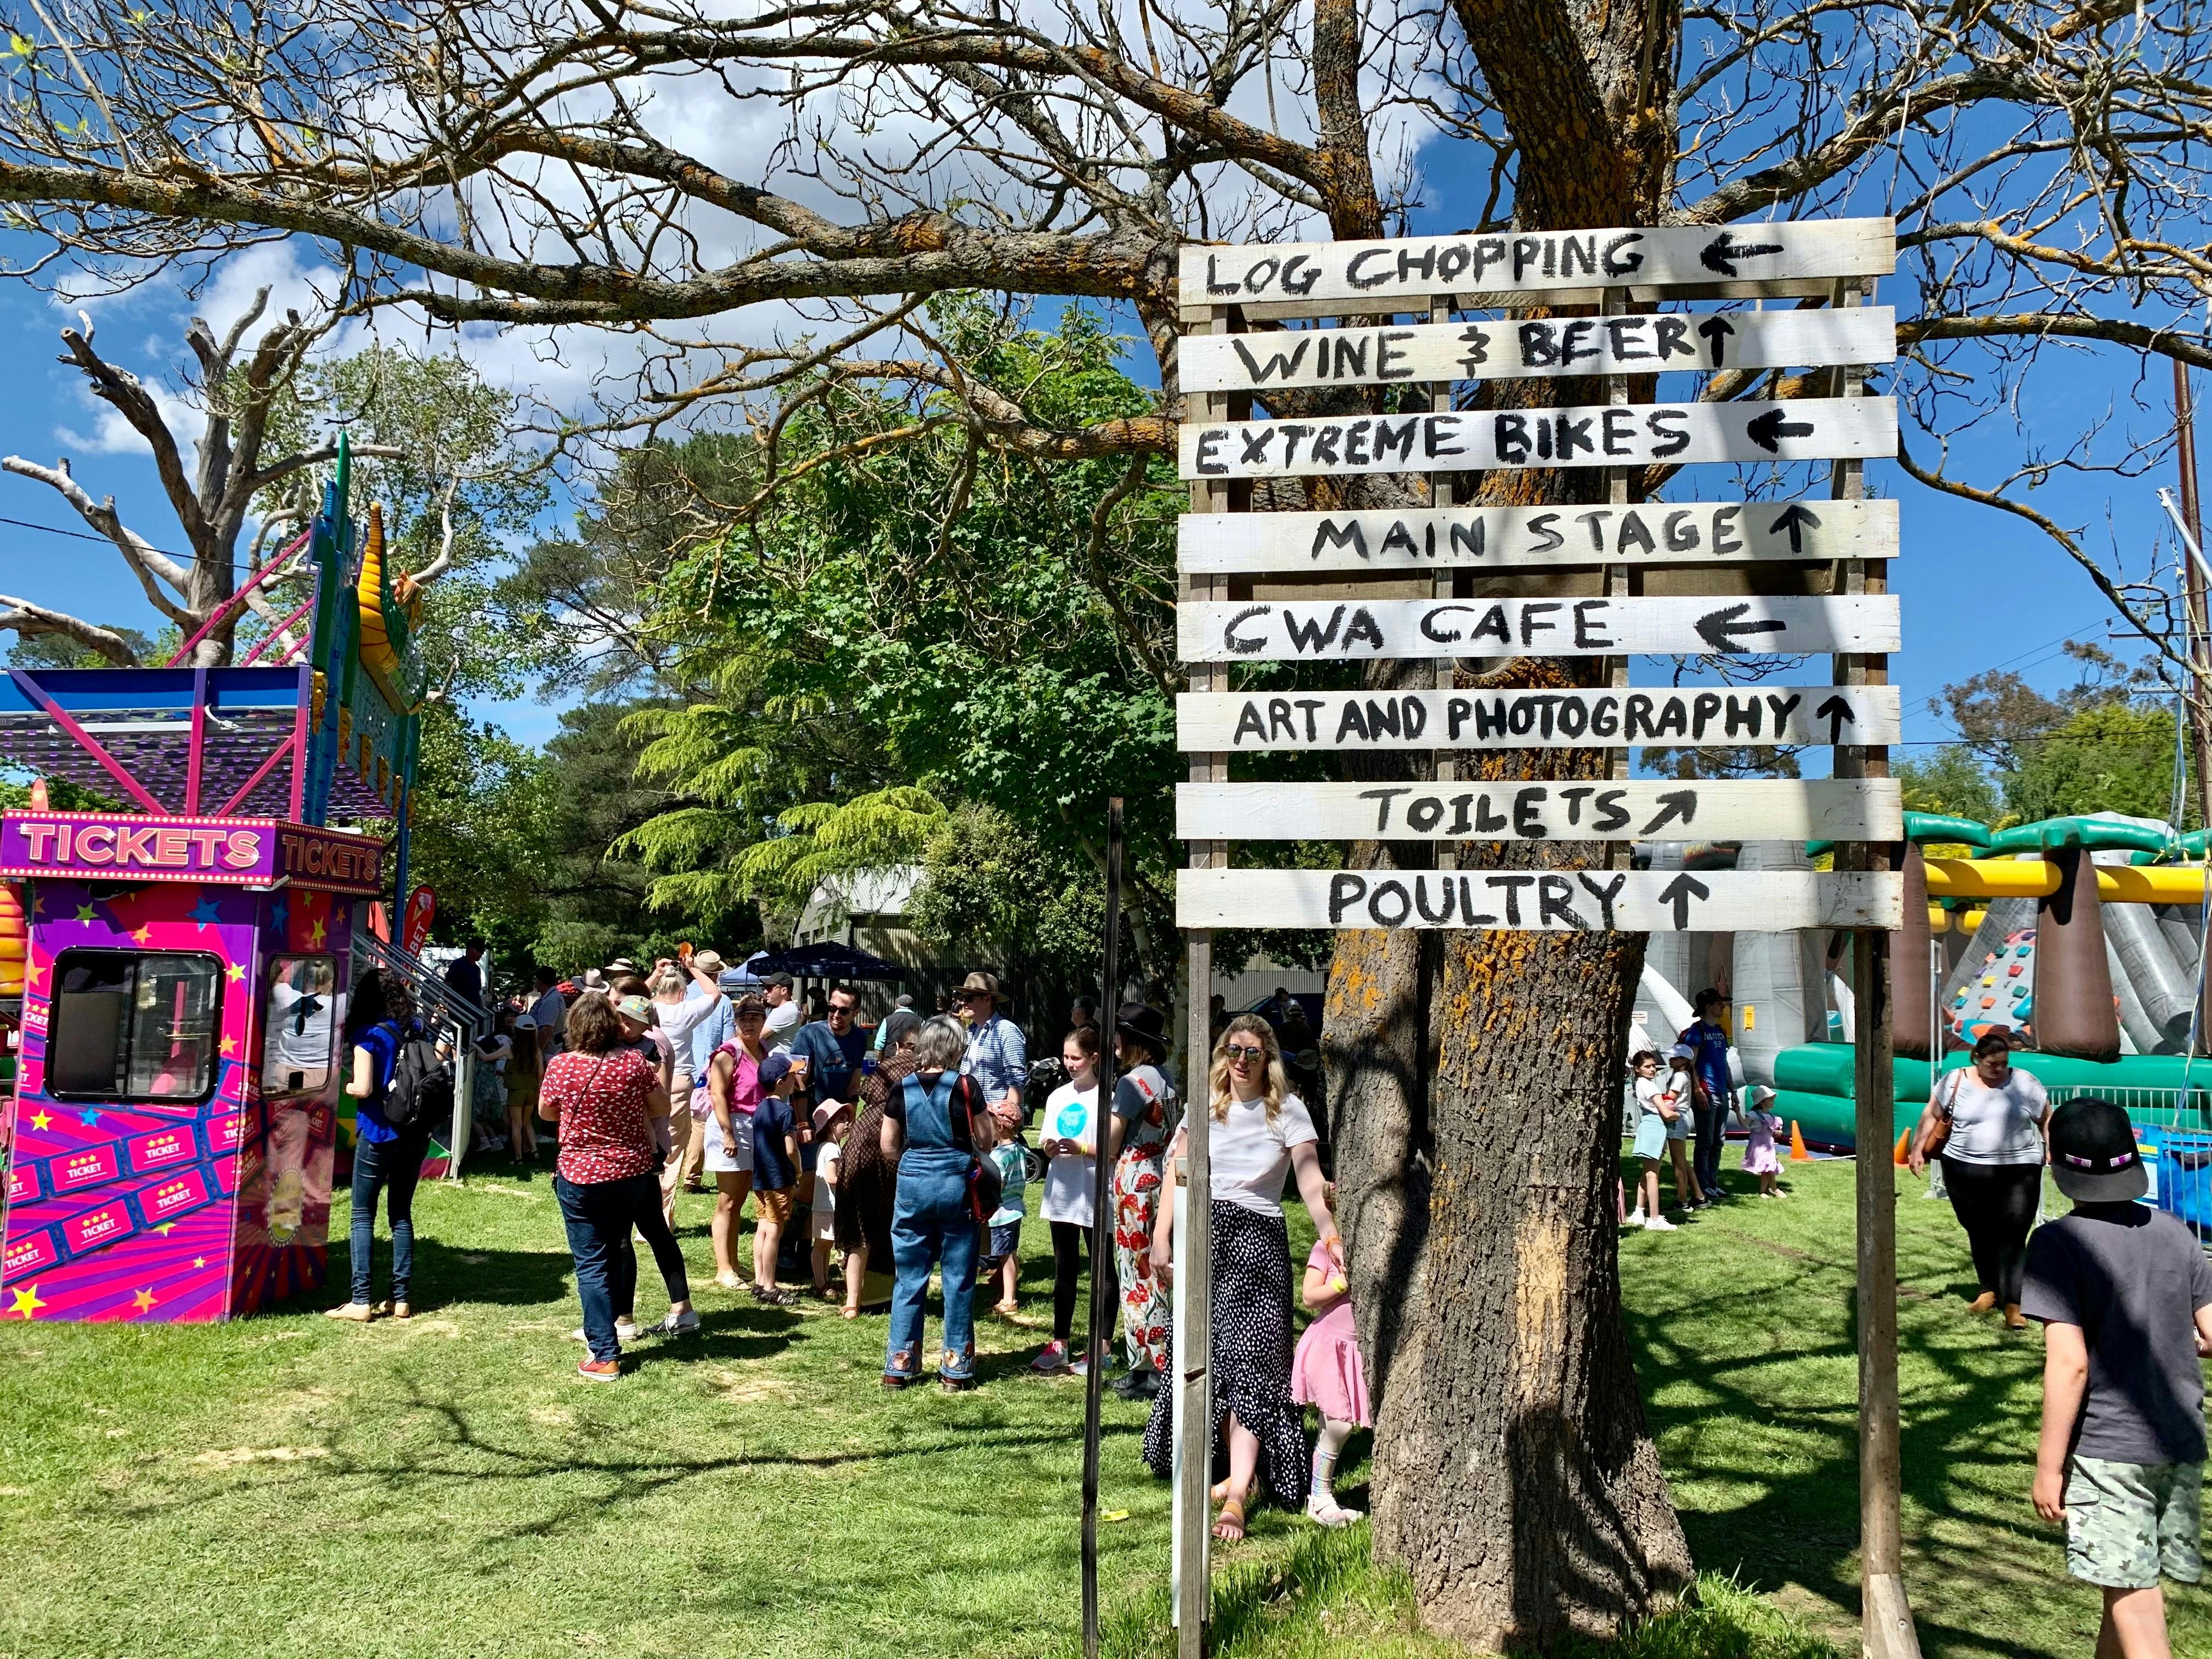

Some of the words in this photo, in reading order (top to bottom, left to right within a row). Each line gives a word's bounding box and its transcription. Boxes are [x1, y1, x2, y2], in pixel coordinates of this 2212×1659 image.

[1207, 254, 1321, 295] LOG
[1346, 233, 1645, 290] CHOPPING
[1232, 331, 1416, 383] WINE
[1519, 315, 1695, 368] BEER
[1197, 414, 1470, 475] EXTREME
[1495, 409, 1690, 465] BIKES
[1312, 516, 1485, 558] MAIN
[1527, 506, 1742, 555] STAGE
[1225, 605, 1384, 654] CWA
[1421, 601, 1613, 648] CAFE
[1234, 698, 1325, 745] ART
[1336, 696, 1426, 743] AND
[1448, 693, 1802, 741] PHOTOGRAPHY
[1361, 787, 1630, 838] TOILETS
[22, 823, 261, 867] TICKETS
[283, 834, 377, 881] TICKETS
[1329, 872, 1626, 929] POULTRY
[25, 1012, 49, 1026] CKET
[66, 1162, 101, 1178] TICKET
[144, 1143, 180, 1158] TICKET
[156, 1188, 190, 1207] TICKET
[81, 1218, 115, 1238] TICKET
[5, 1249, 39, 1269] TICKET
